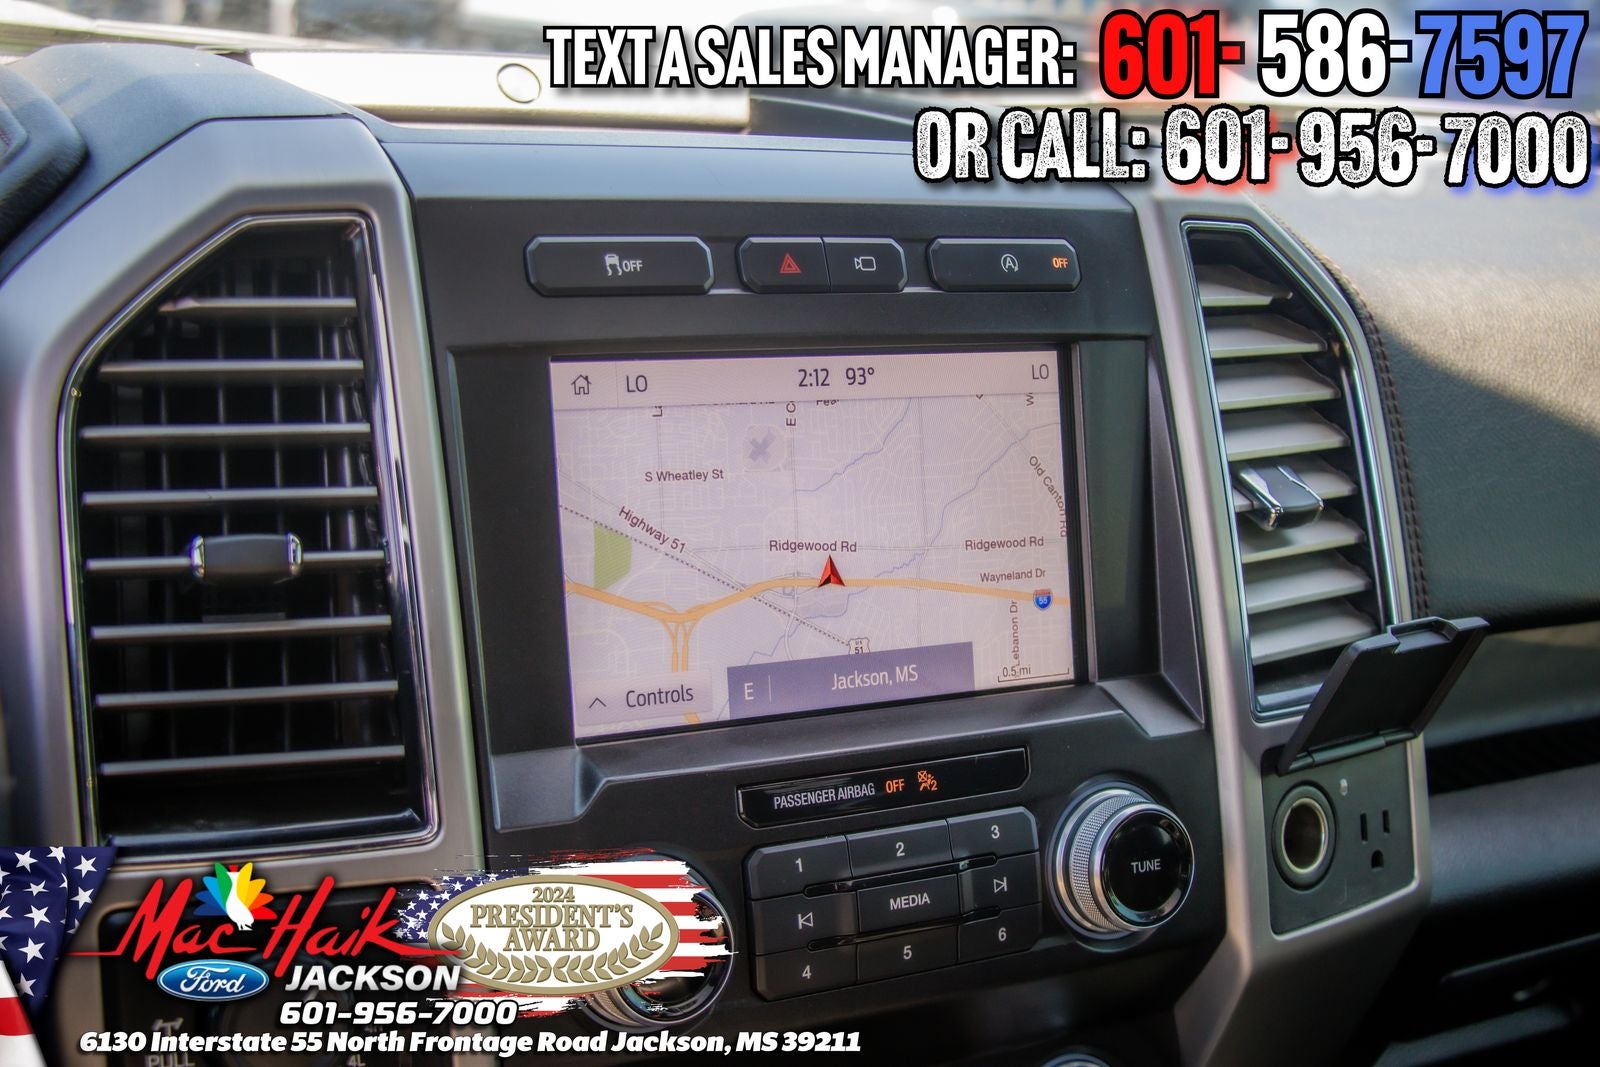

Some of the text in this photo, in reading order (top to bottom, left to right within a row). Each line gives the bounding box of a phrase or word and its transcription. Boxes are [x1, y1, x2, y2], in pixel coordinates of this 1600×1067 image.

[622, 259, 643, 272] OFF
[1052, 257, 1068, 268] OFF
[798, 367, 875, 387] 2:12 93°
[1031, 364, 1049, 380] LO
[626, 374, 648, 393] LO
[1029, 455, 1045, 477] Old
[645, 469, 724, 484] S Wheatley St
[618, 506, 686, 554] Highway 51
[769, 539, 857, 553] Ridgewood Rd
[965, 536, 1044, 552] Ridgewood Rd
[979, 568, 1046, 583] Wayneland Dr
[1002, 664, 1031, 677] 0.5 mi
[744, 665, 918, 700] E Jackson, MS
[626, 684, 694, 708] Controls
[885, 778, 905, 794] OFF
[773, 783, 875, 810] PASSENGER AIRBAG
[991, 825, 1000, 840] 3
[895, 842, 905, 857] 2
[795, 858, 803, 873] 1
[1131, 859, 1161, 874] TUNE
[889, 892, 930, 911] MEDIA
[998, 927, 1007, 942] 6
[903, 946, 912, 960] 5
[801, 965, 812, 980] 4
